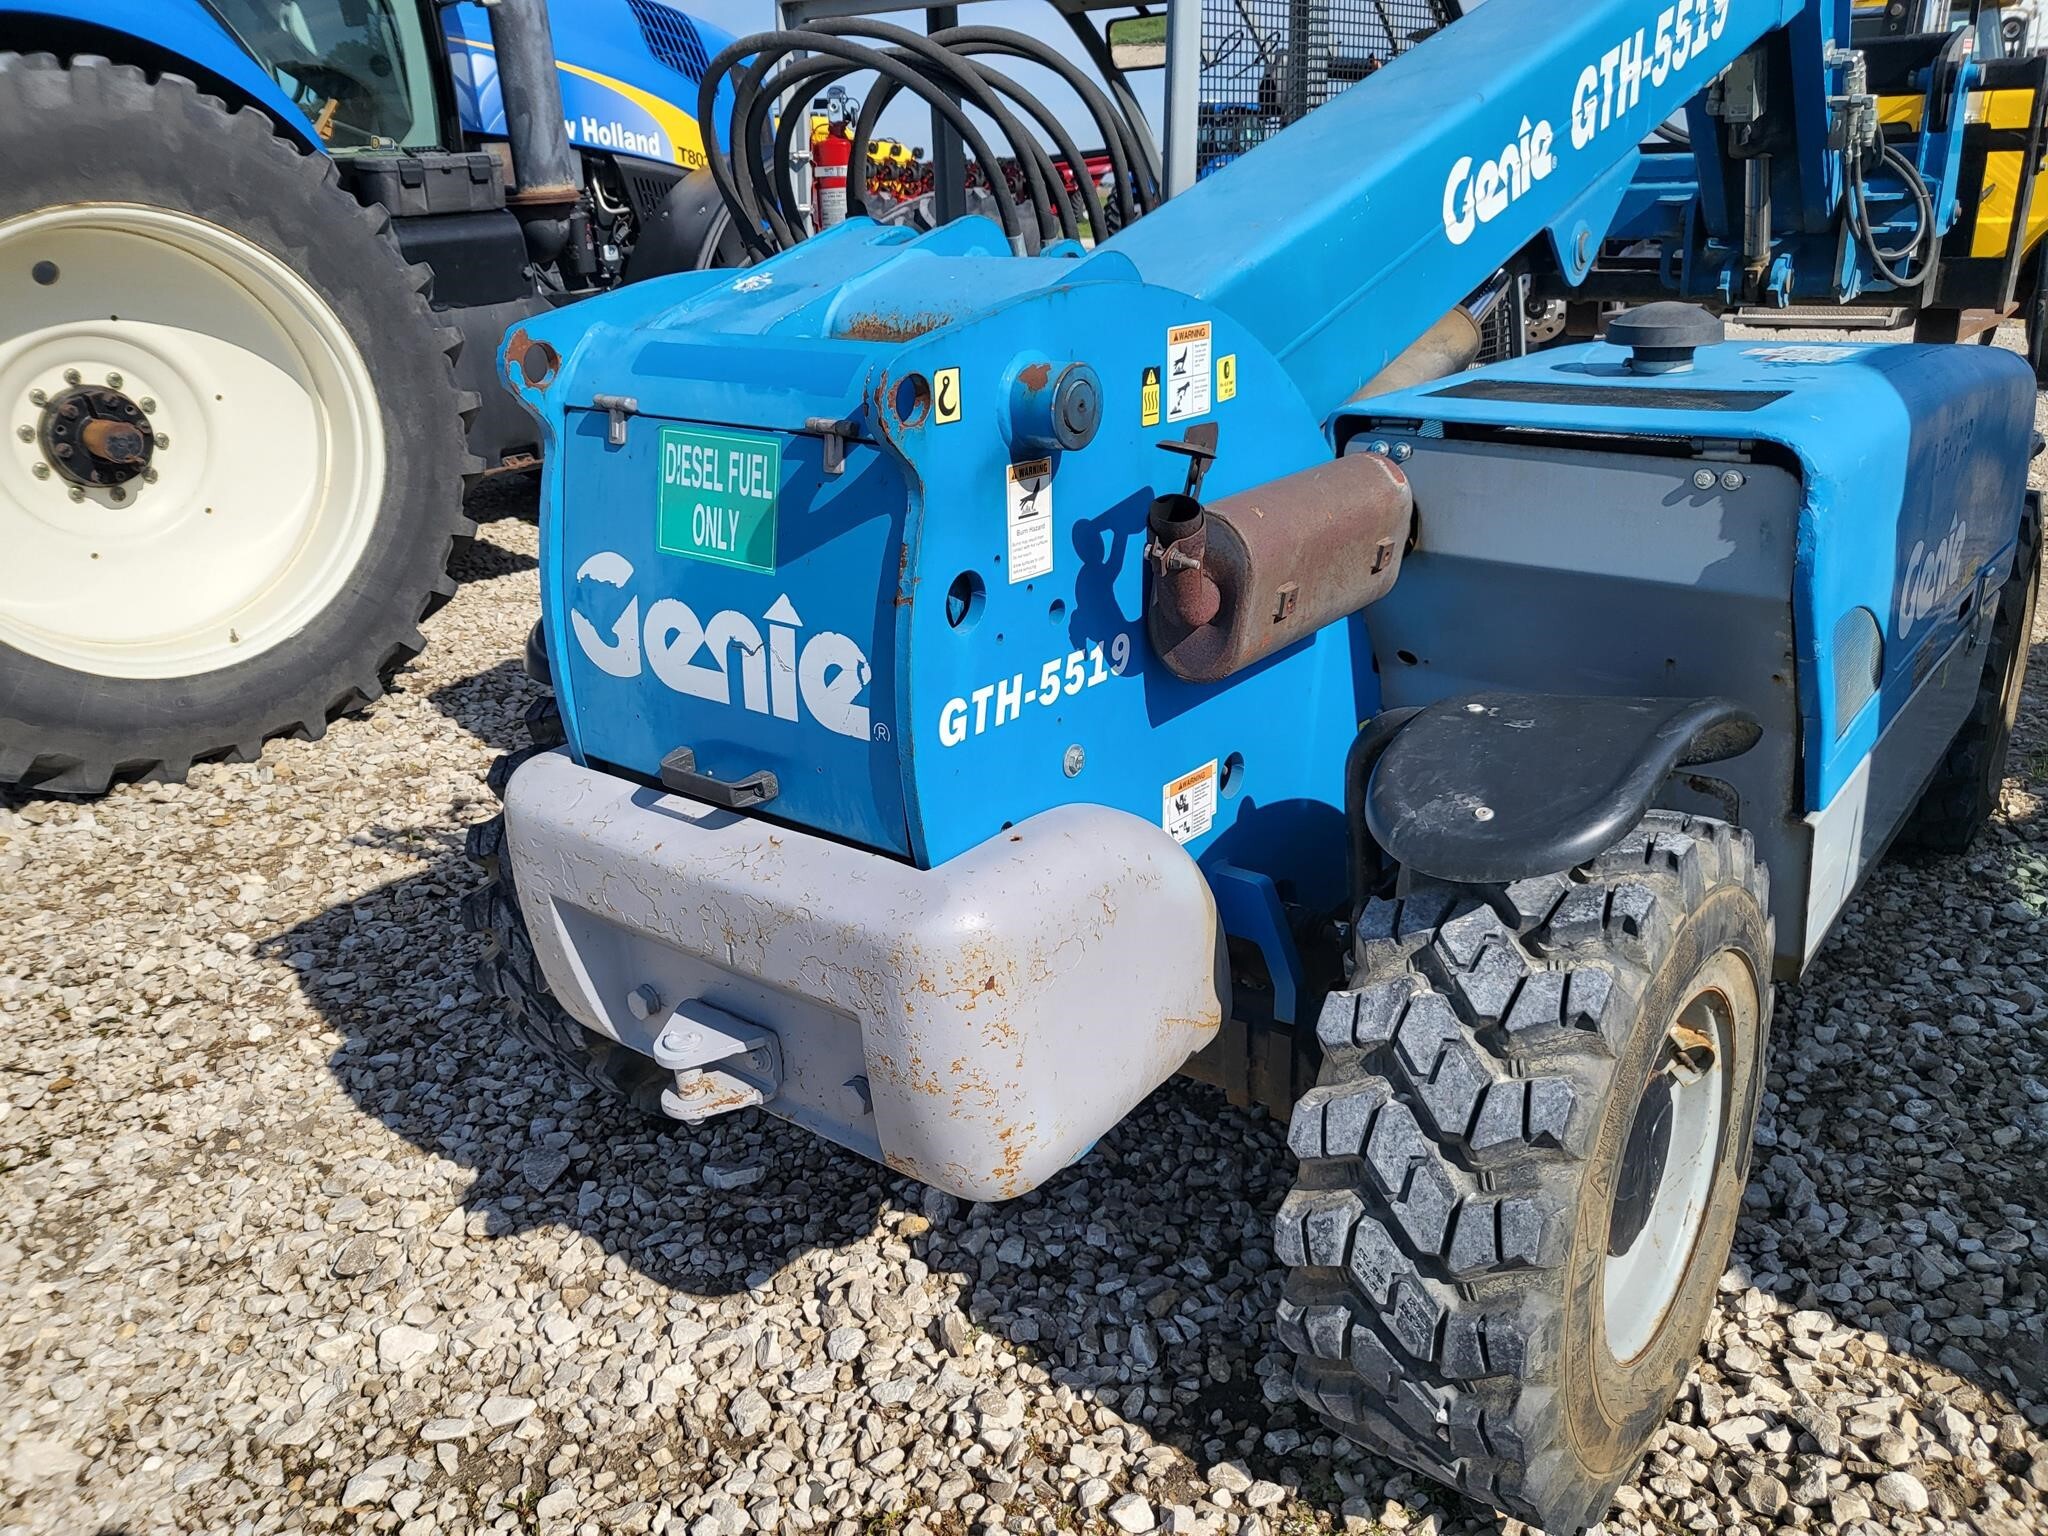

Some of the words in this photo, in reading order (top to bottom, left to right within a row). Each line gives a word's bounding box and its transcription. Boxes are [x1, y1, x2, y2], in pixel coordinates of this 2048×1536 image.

[1570, 0, 1730, 150] GTH-5519
[581, 116, 661, 157] Holland
[678, 146, 708, 168] T80
[1443, 115, 1553, 245] Genie
[1179, 328, 1205, 341] WARNING
[664, 443, 724, 493] DIESEL
[728, 451, 773, 500] FUEL
[1019, 463, 1048, 478] WARNING
[692, 503, 740, 551] ONLY
[1899, 510, 1967, 640] Genie
[571, 551, 872, 742] Genie
[938, 633, 1131, 748] GTH-5519
[1182, 772, 1206, 787] WARNING
